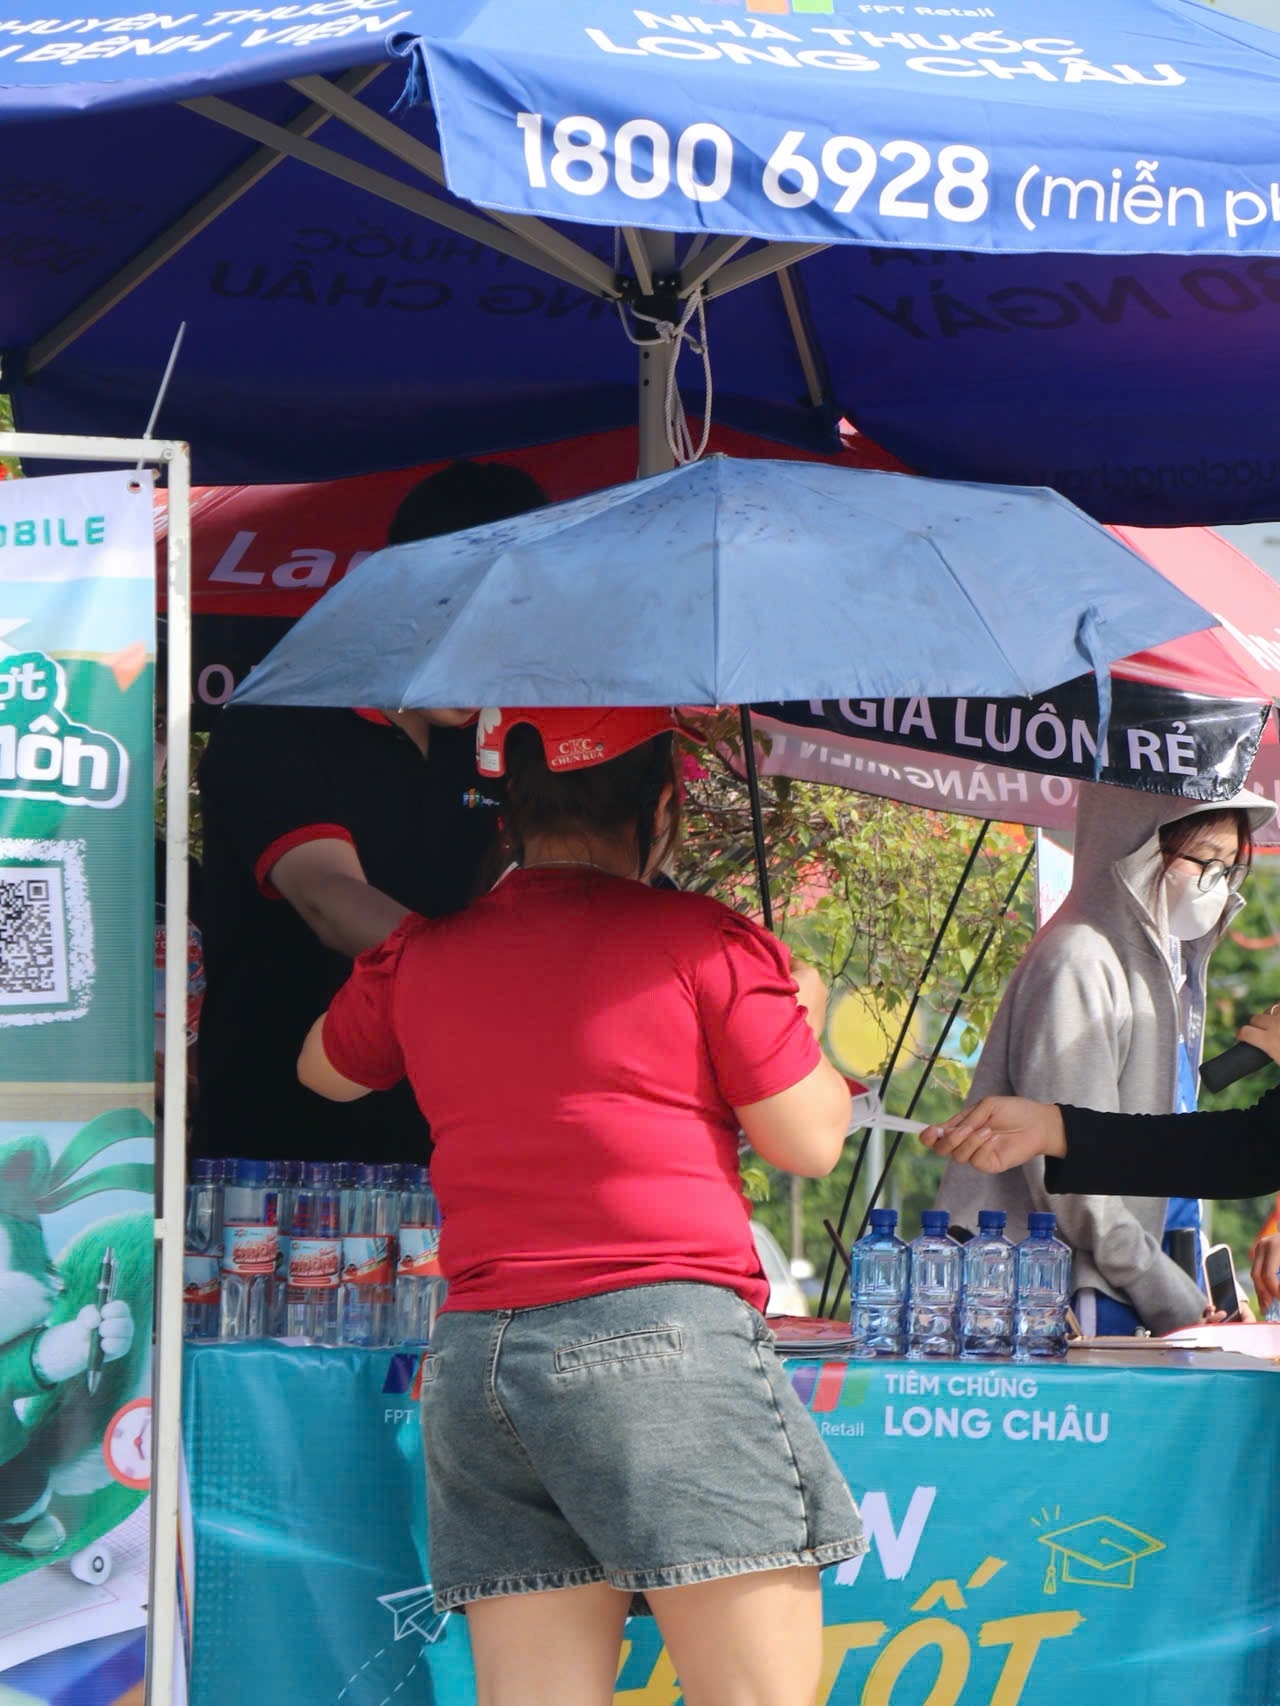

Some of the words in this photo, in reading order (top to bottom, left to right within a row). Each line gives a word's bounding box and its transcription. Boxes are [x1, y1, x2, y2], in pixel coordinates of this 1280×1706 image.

[858, 4, 905, 15] FPT
[15, 31, 233, 65] BỆNH
[240, 11, 413, 47] VIỆN
[633, 10, 803, 42] NHÀ
[811, 28, 1085, 56] THUỐC
[585, 27, 881, 71] LONG
[906, 54, 1188, 87] CHÂU
[516, 112, 733, 201] 1800
[762, 130, 990, 222] 6928
[1016, 160, 1206, 231] (miễn
[0, 515, 105, 546] BILE
[208, 531, 374, 588] La
[955, 699, 1109, 768] LUÔN
[1127, 721, 1198, 776] RẺ
[885, 1369, 940, 1396] TIÊM
[384, 1408, 414, 1425] FPT
[821, 1421, 865, 1437] Retail
[885, 1406, 991, 1439] LONG
[1003, 1404, 1109, 1443] CHÂU
